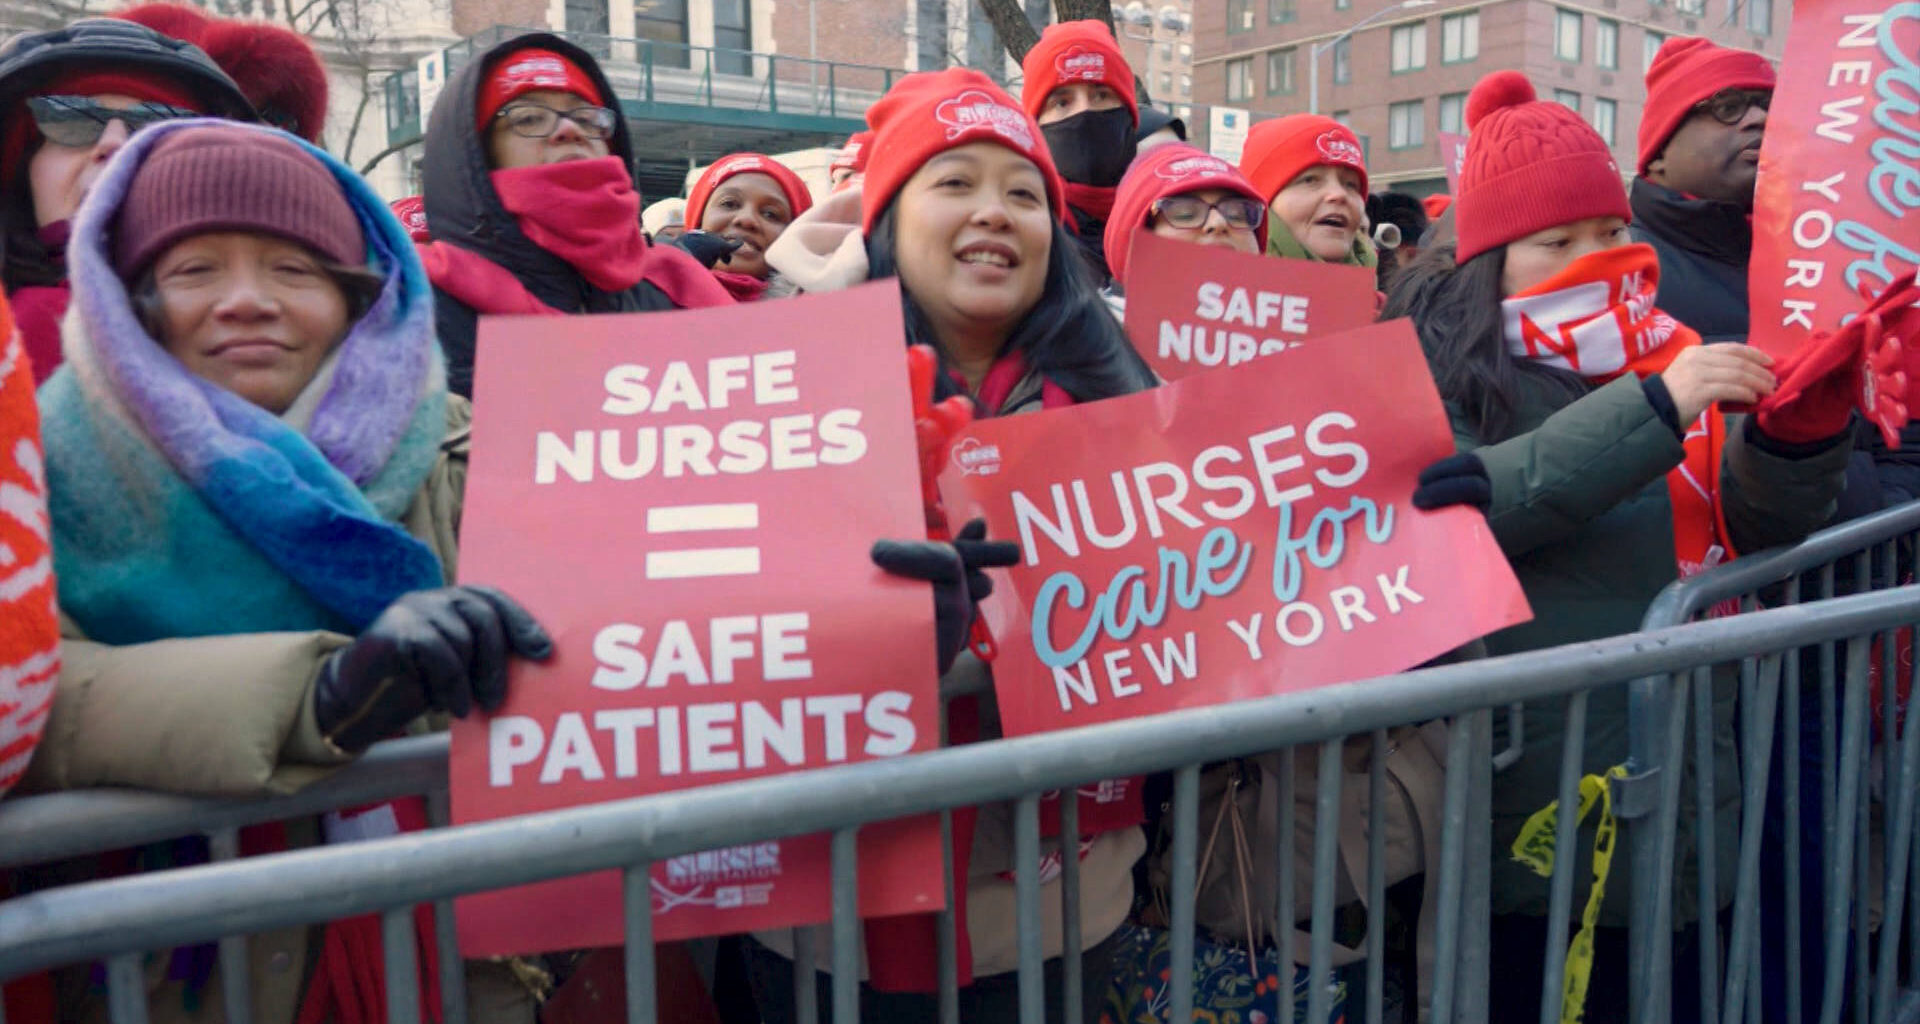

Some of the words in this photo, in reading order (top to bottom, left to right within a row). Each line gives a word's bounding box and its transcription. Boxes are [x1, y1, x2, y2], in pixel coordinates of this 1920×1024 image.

[1815, 12, 1884, 145] NEW
[1782, 171, 1848, 330] YORK
[1195, 282, 1309, 334] SAFE
[602, 350, 799, 415] SAFE
[535, 408, 868, 484] NURSES
[1011, 411, 1370, 567] NURSES
[1031, 527, 1251, 669] Care
[1272, 495, 1394, 601] for
[1052, 631, 1199, 712] NEW
[1226, 563, 1426, 662] YORK
[591, 611, 813, 691] SAFE
[489, 691, 916, 787] PATIENTS
